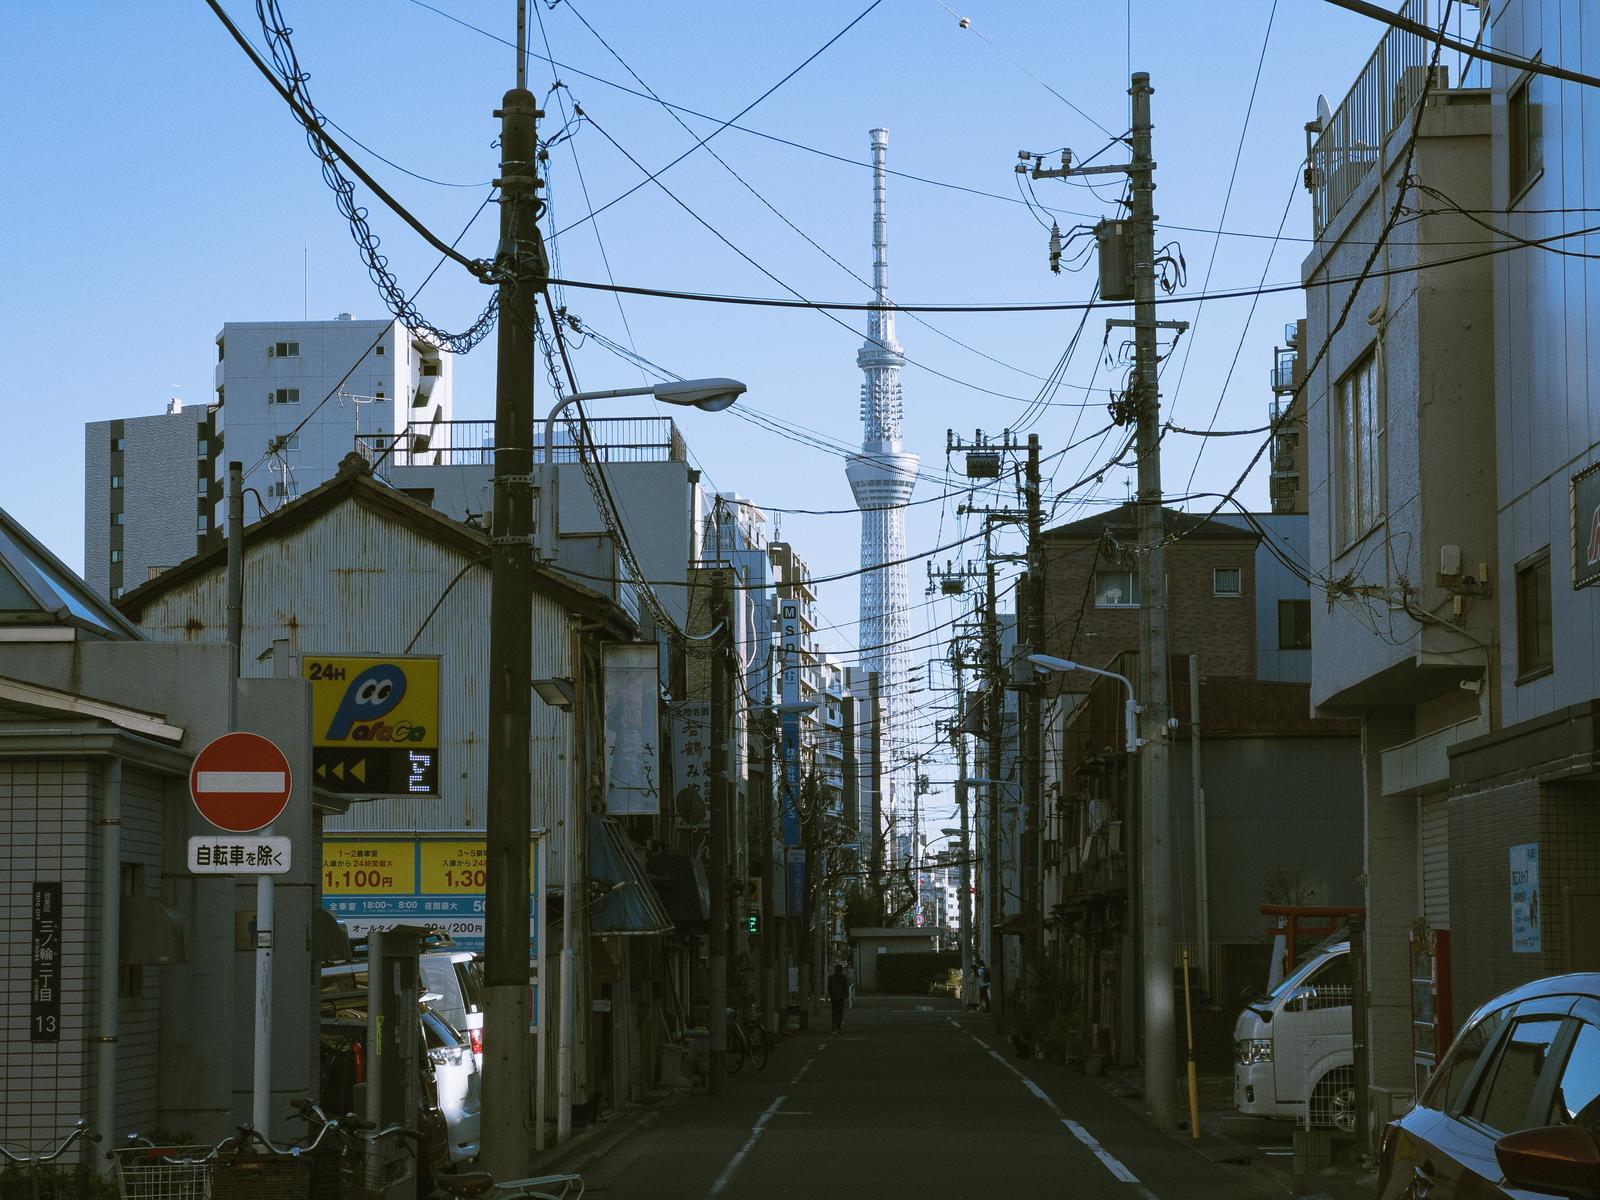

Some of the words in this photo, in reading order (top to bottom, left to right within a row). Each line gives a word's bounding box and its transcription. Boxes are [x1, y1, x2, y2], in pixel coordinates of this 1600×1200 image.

[310, 663, 346, 681] 24H
[196, 845, 282, 866] 自転車を除く
[325, 870, 393, 888] 1,100円
[398, 901, 418, 909] 8:00
[424, 902, 458, 911] 夜間最大
[40, 920, 54, 1002] 三ノ輪二丁目
[36, 1015, 56, 1033] 13
